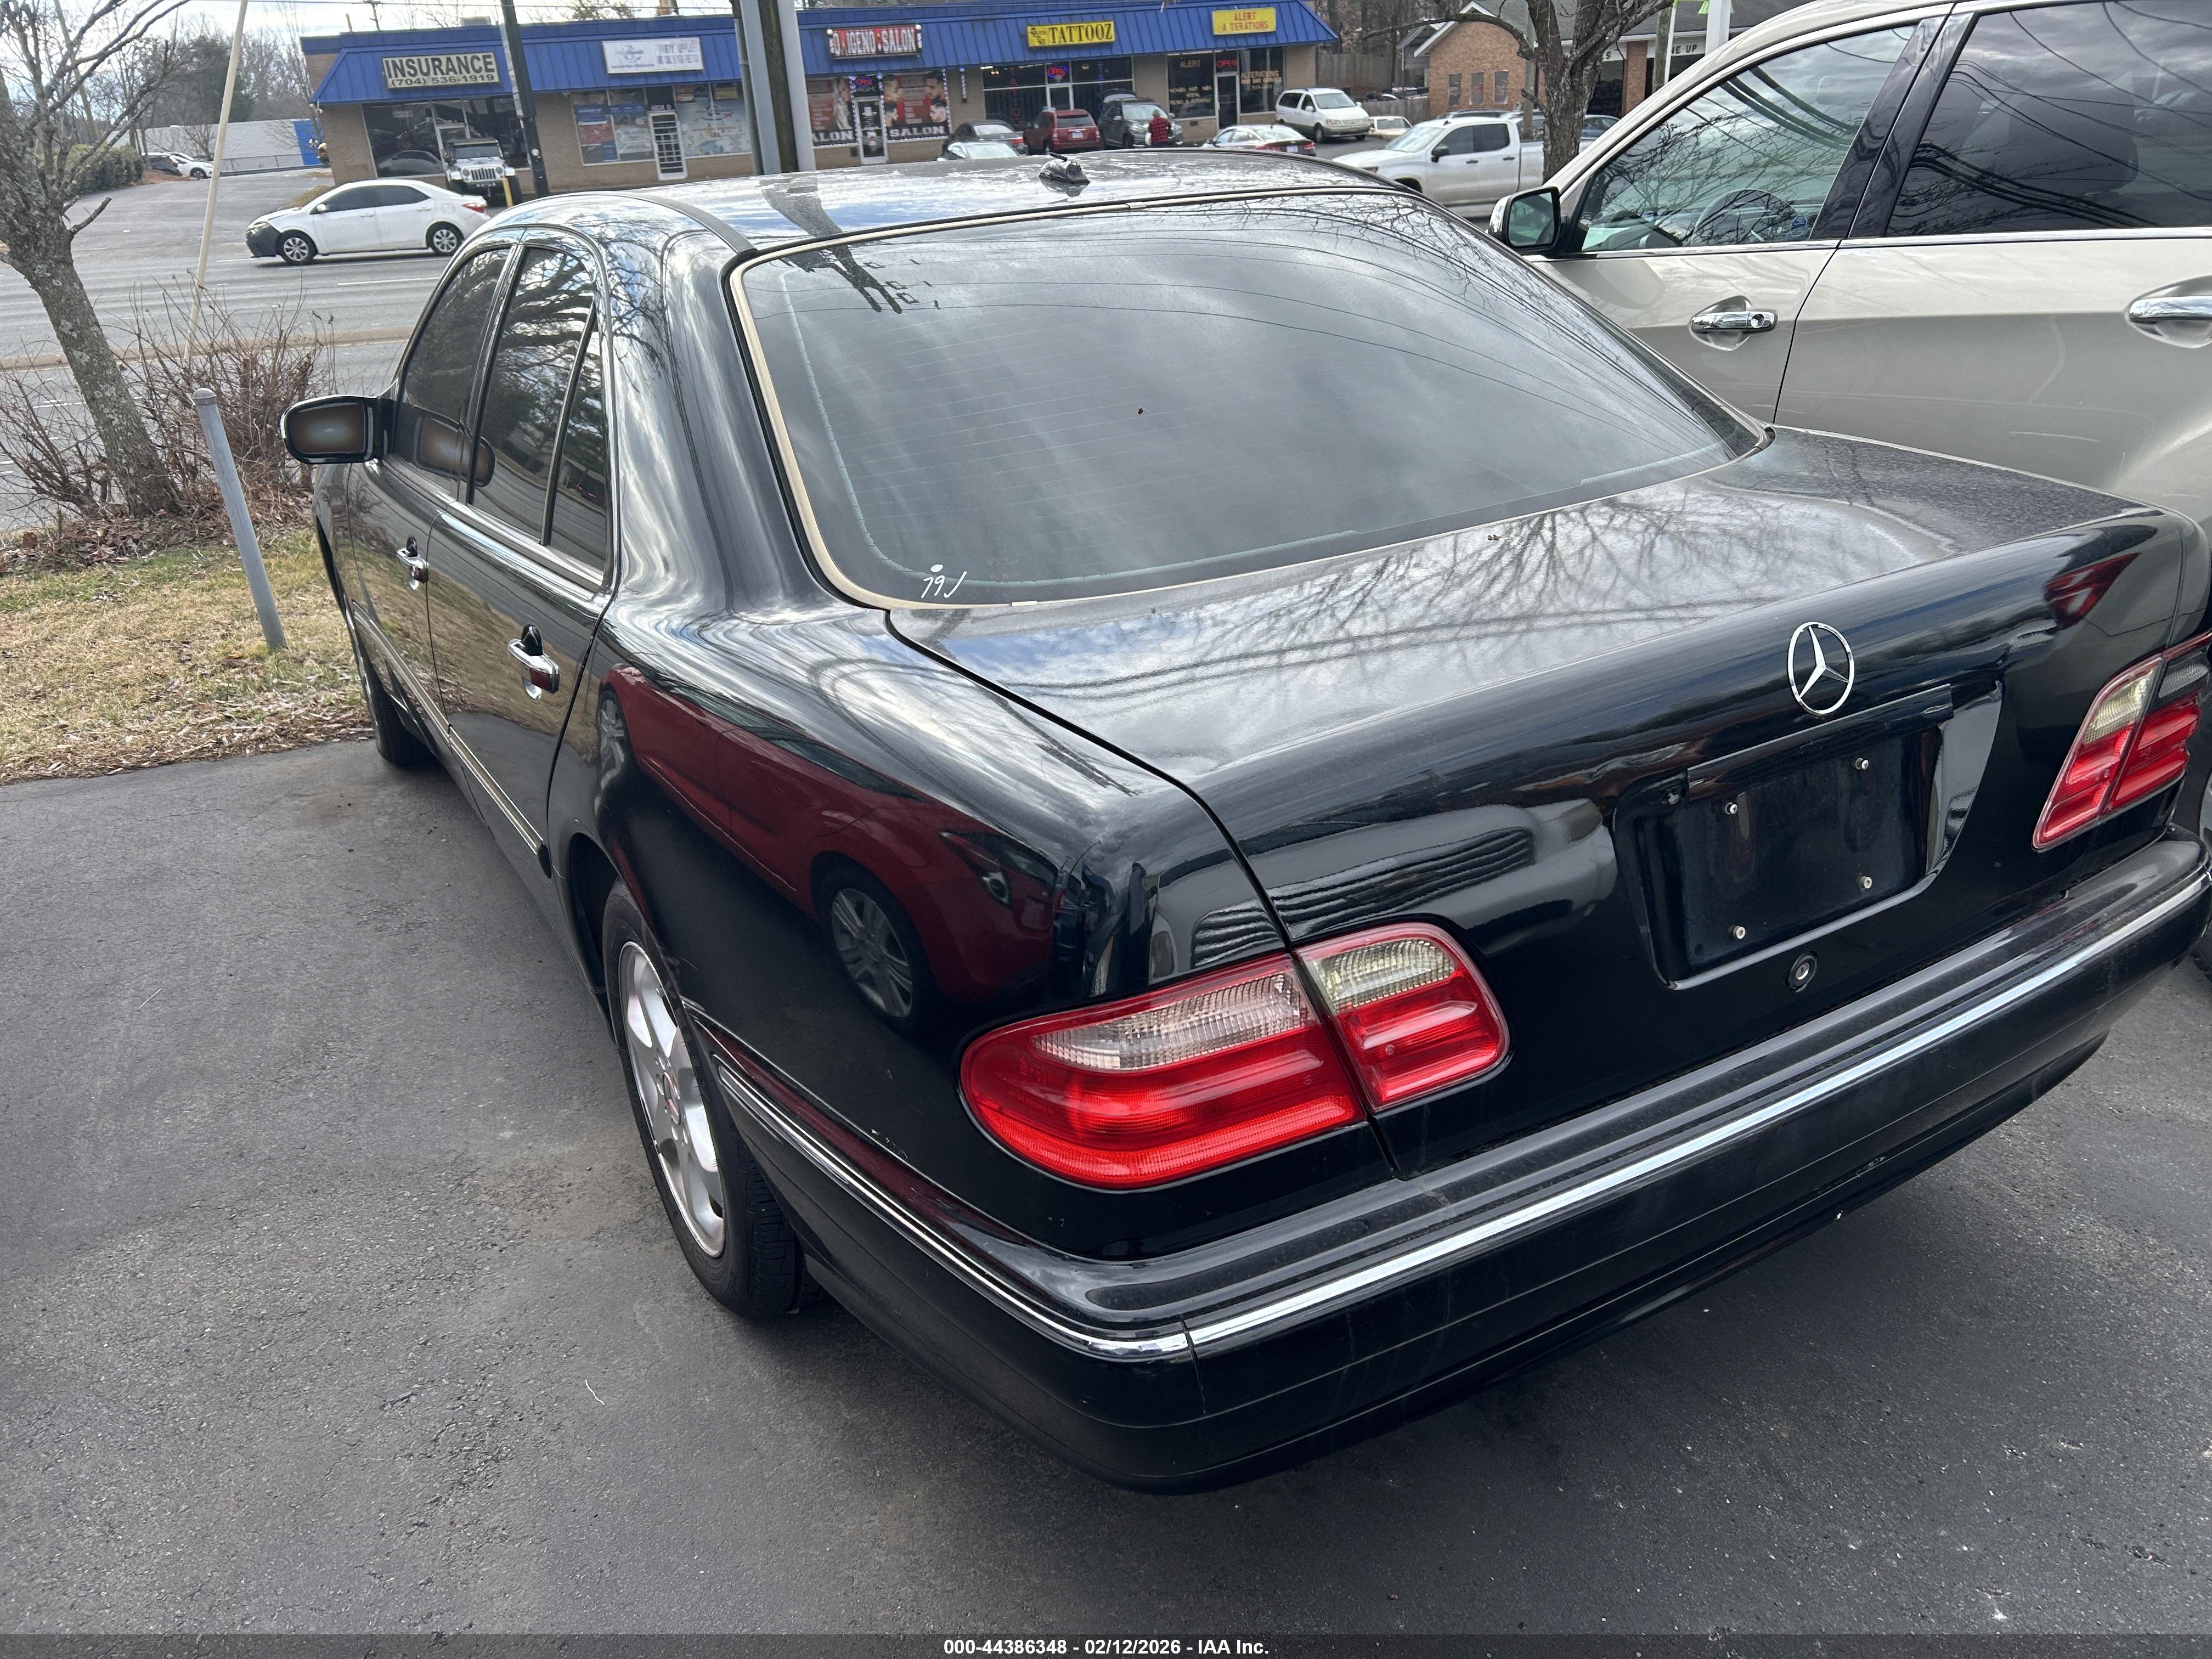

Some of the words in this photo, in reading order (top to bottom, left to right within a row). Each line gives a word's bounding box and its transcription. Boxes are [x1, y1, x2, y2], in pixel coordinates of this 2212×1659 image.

[1222, 21, 1268, 32] ATERATIONS
[1048, 23, 1113, 43] TATTOOZ
[881, 28, 917, 54] SALON
[1685, 43, 1697, 53] UP
[385, 54, 495, 78] INSURANCE
[1216, 59, 1238, 68] OPEN
[391, 78, 426, 87] (704)
[431, 74, 494, 83] 536-1919
[812, 131, 854, 142] ALON
[889, 126, 945, 137] SALON
